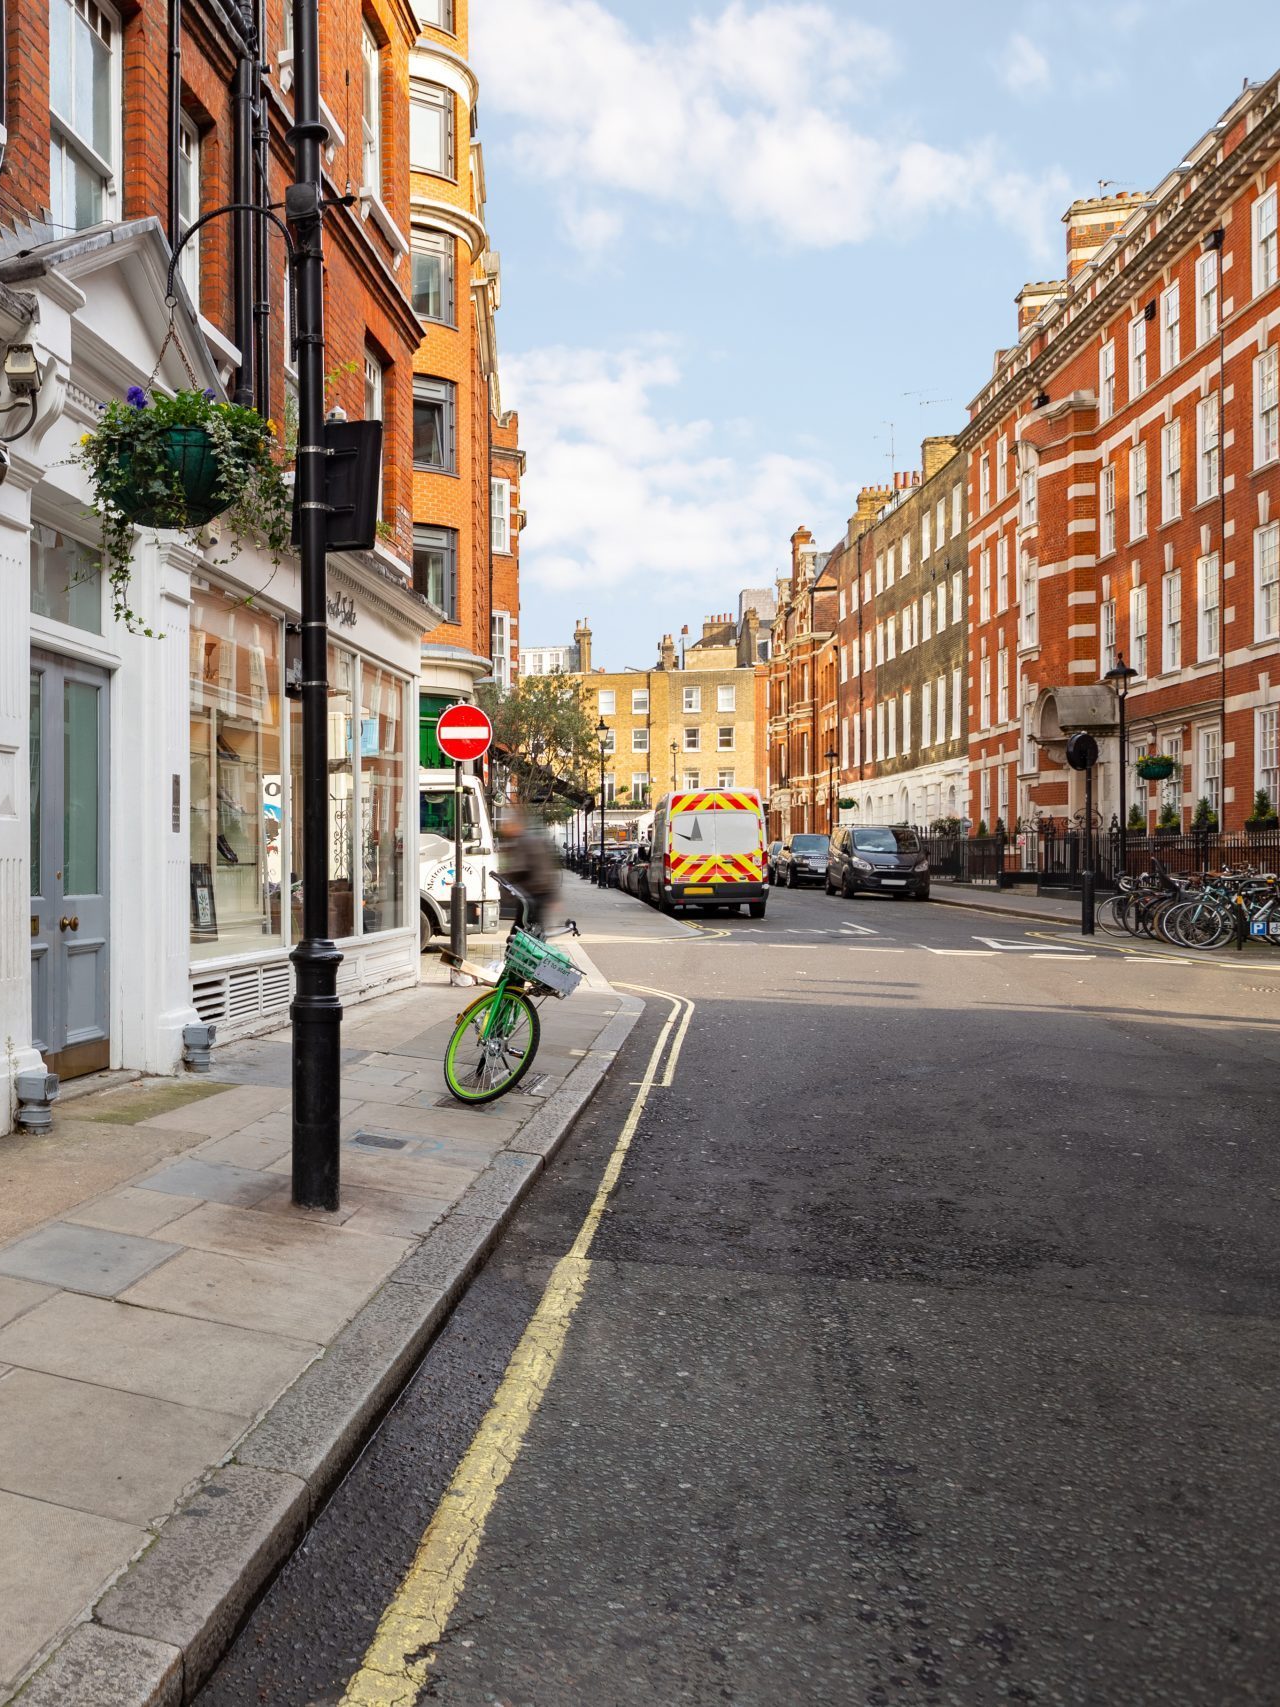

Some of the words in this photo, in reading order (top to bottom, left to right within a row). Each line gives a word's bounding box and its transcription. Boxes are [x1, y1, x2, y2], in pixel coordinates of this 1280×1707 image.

[426, 865, 448, 891] Metrow
[1253, 923, 1264, 934] P
[542, 957, 551, 966] £1
[556, 966, 571, 977] start
